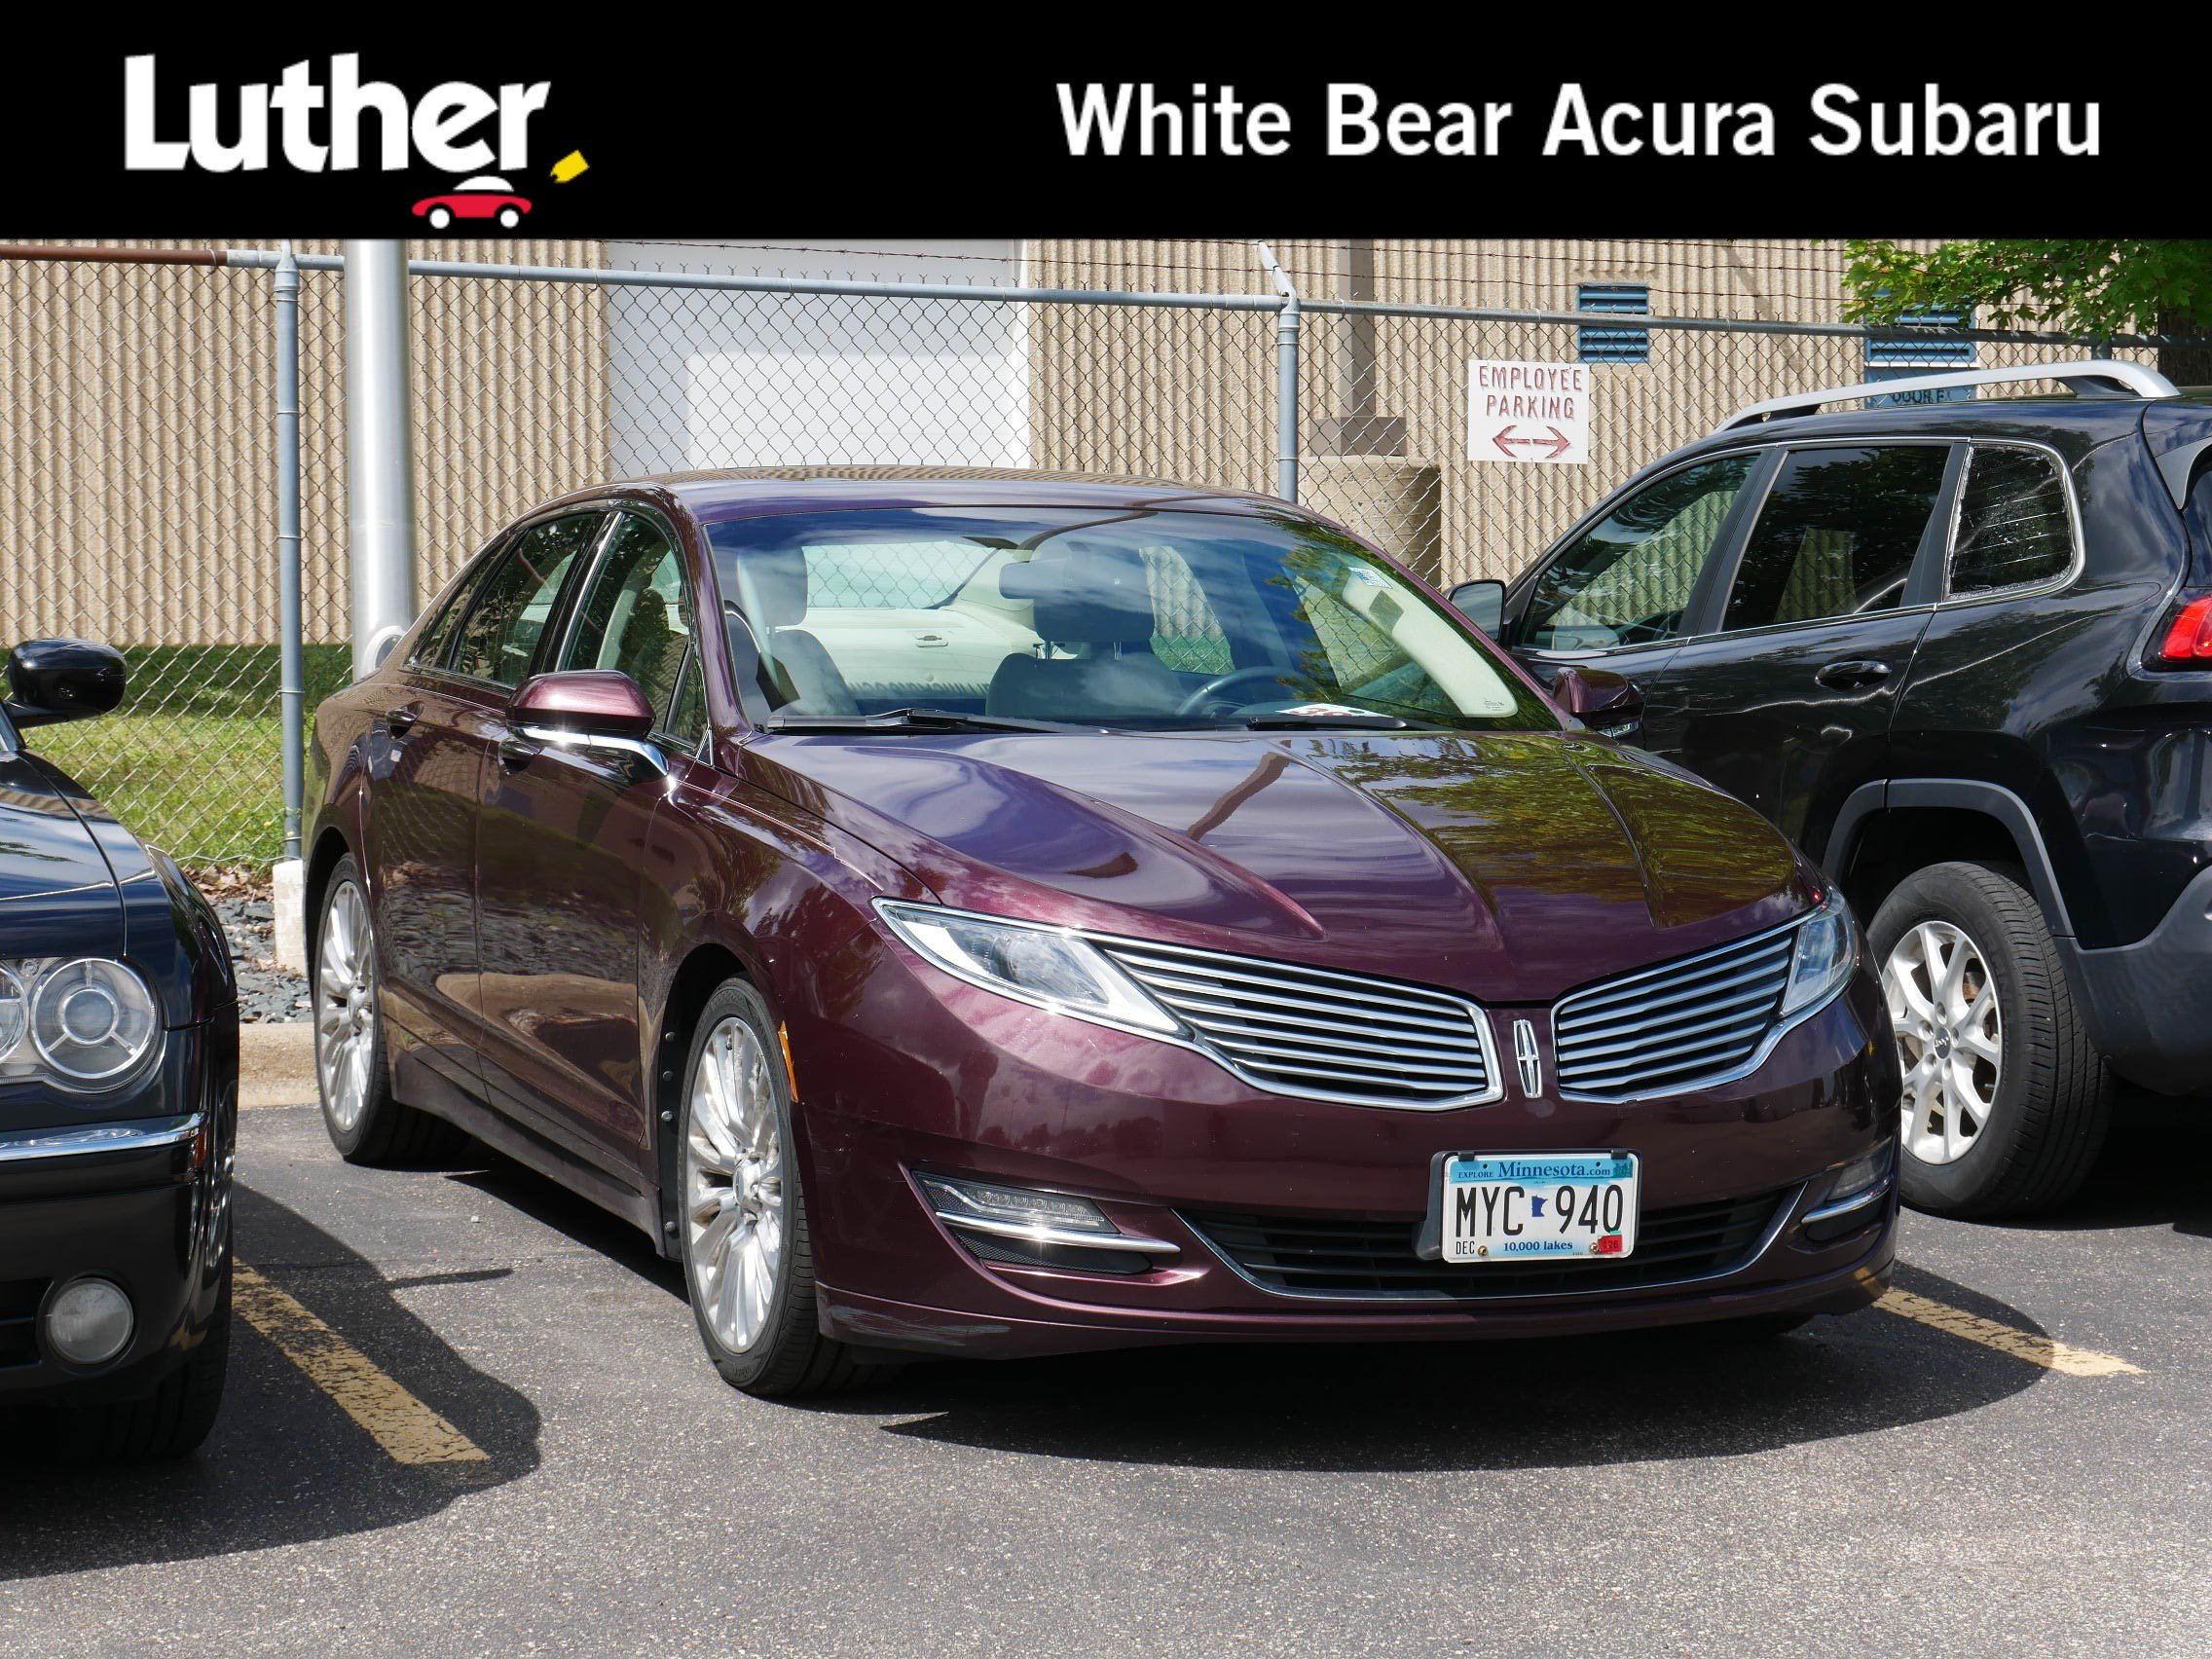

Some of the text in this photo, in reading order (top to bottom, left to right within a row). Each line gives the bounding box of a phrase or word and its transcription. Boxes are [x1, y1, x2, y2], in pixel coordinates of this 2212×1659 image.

[1479, 365, 1582, 390] EMPLOYEE
[1486, 394, 1575, 419] PARKING
[1456, 1185, 1624, 1237] MYC 940
[1456, 1240, 1475, 1255] DEC
[1503, 1240, 1573, 1252] 10,000 lakes
